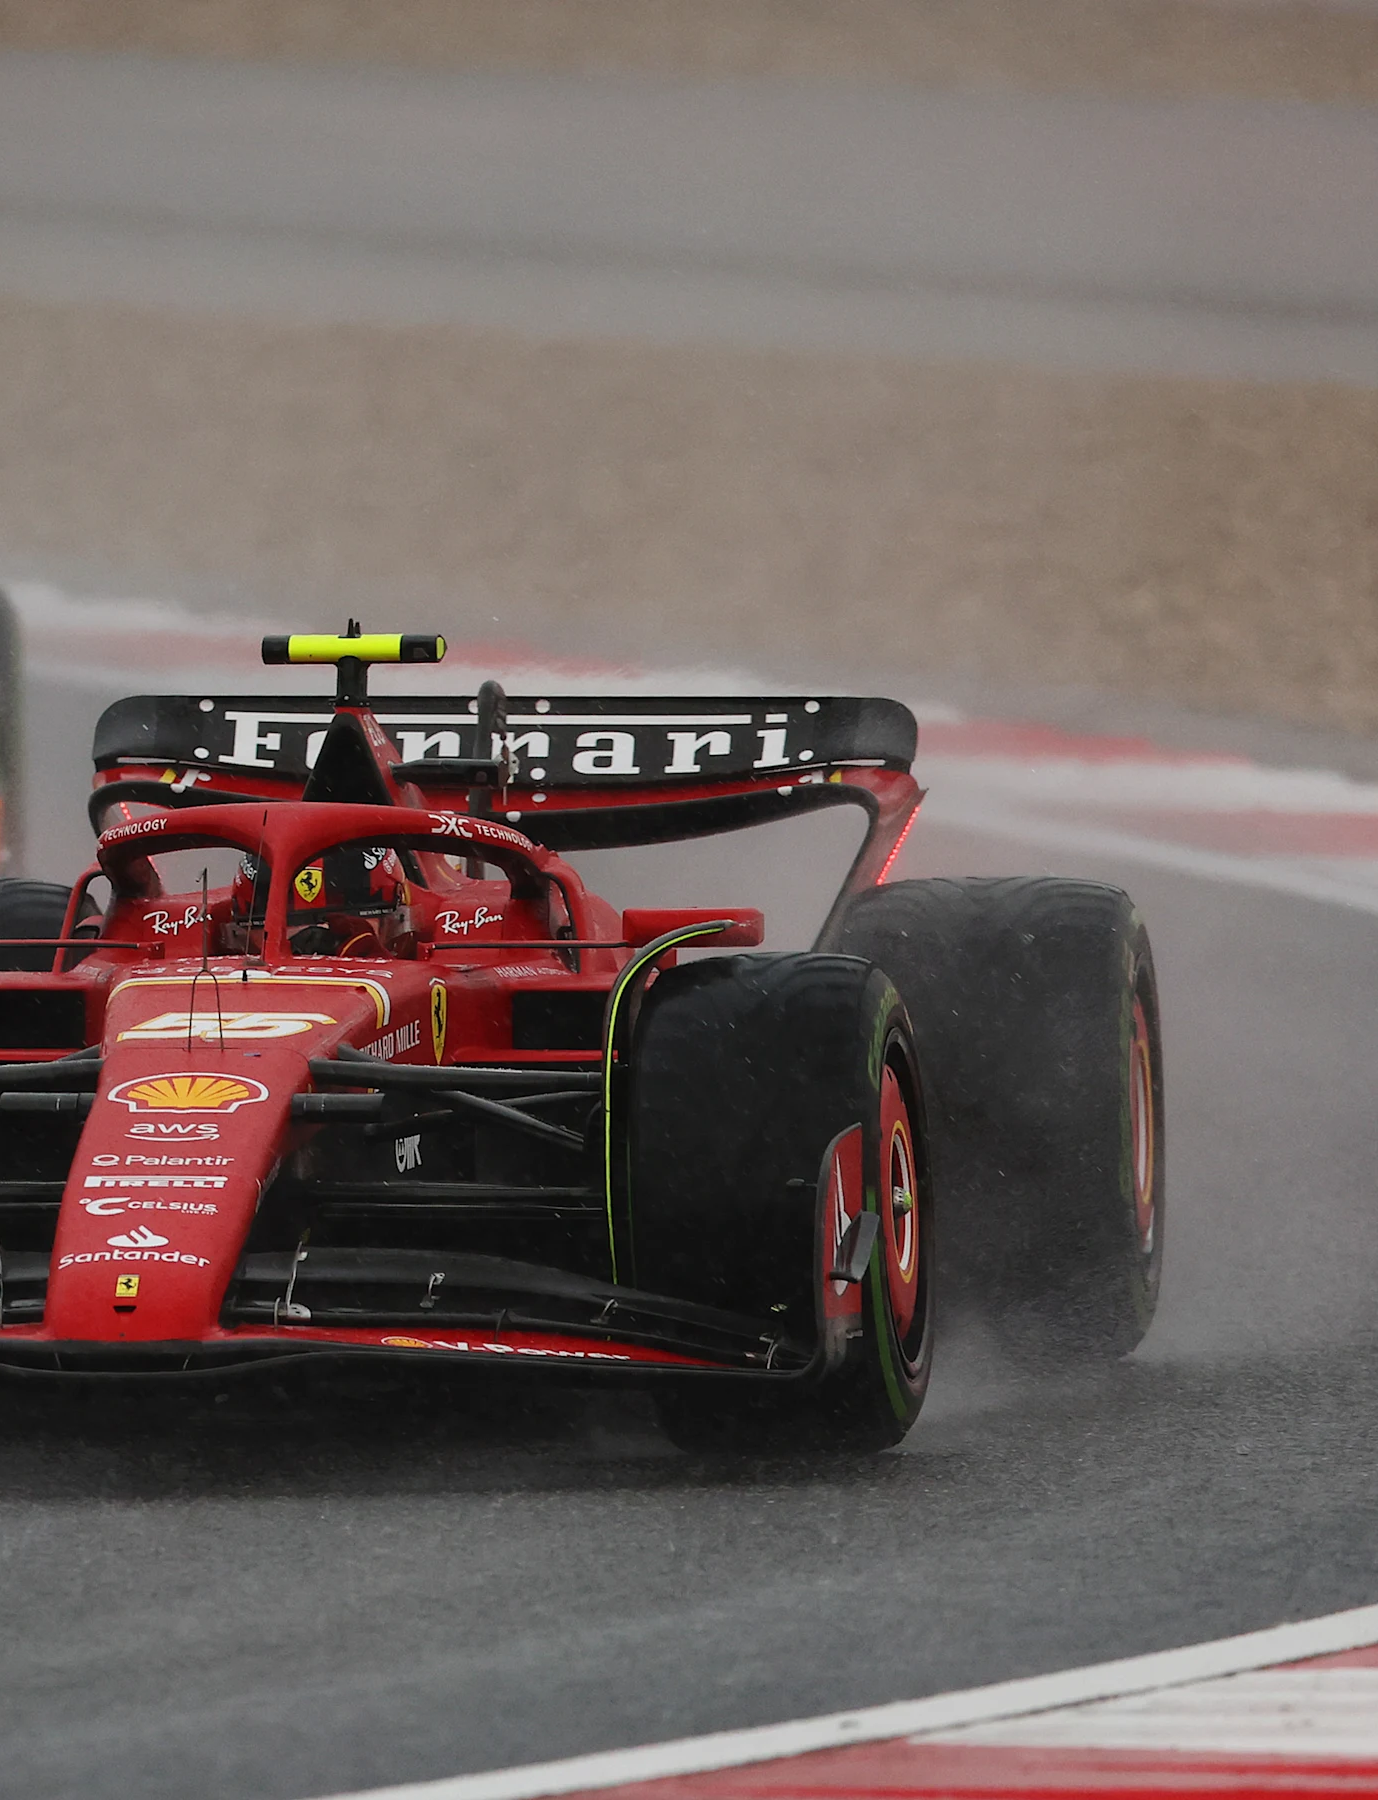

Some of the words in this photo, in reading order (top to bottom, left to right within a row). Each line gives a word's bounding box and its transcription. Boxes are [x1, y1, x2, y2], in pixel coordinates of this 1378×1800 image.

[103, 818, 167, 842] TECHNOLOGY
[428, 813, 473, 839] DXC
[434, 906, 503, 935] Ray-Ban
[116, 1012, 338, 1043] 55
[358, 1032, 395, 1061] CHARD
[395, 1019, 421, 1055] MILLE
[129, 1122, 220, 1135] aws
[124, 1154, 235, 1166] Palantir
[83, 1175, 229, 1189] PIRELLI
[127, 1200, 219, 1212] CELSIUS
[57, 1248, 211, 1270] Santander
[433, 1340, 631, 1361] V-Power
